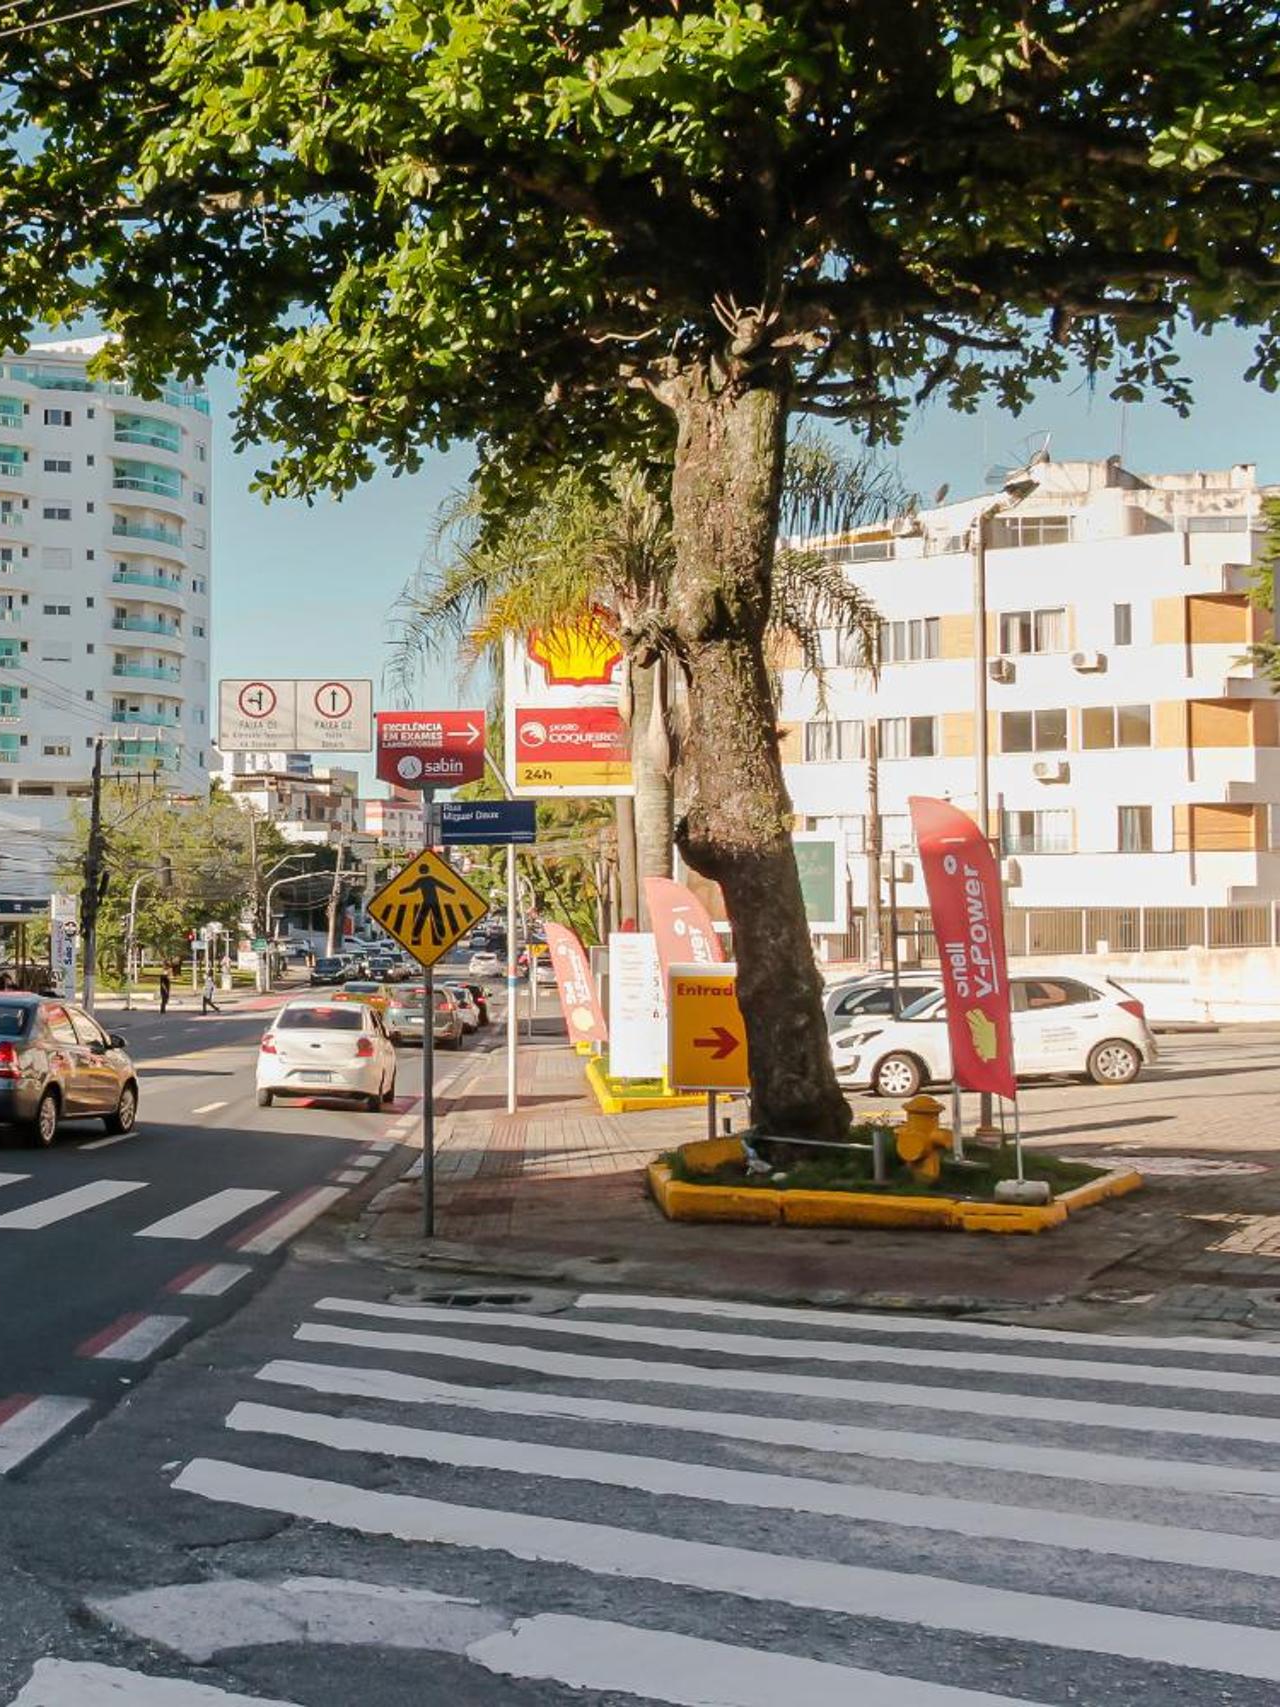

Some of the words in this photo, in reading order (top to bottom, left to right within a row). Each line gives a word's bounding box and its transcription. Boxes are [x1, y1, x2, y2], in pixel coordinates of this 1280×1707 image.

[383, 722, 443, 732] EXCELÊNCIA
[383, 732, 399, 741] EM
[401, 732, 443, 741] EXAMES
[424, 757, 463, 773] sabin
[525, 769, 552, 780] 24h
[443, 803, 461, 812] Rua
[963, 863, 994, 998] V-Power
[677, 983, 734, 996] Entrad
